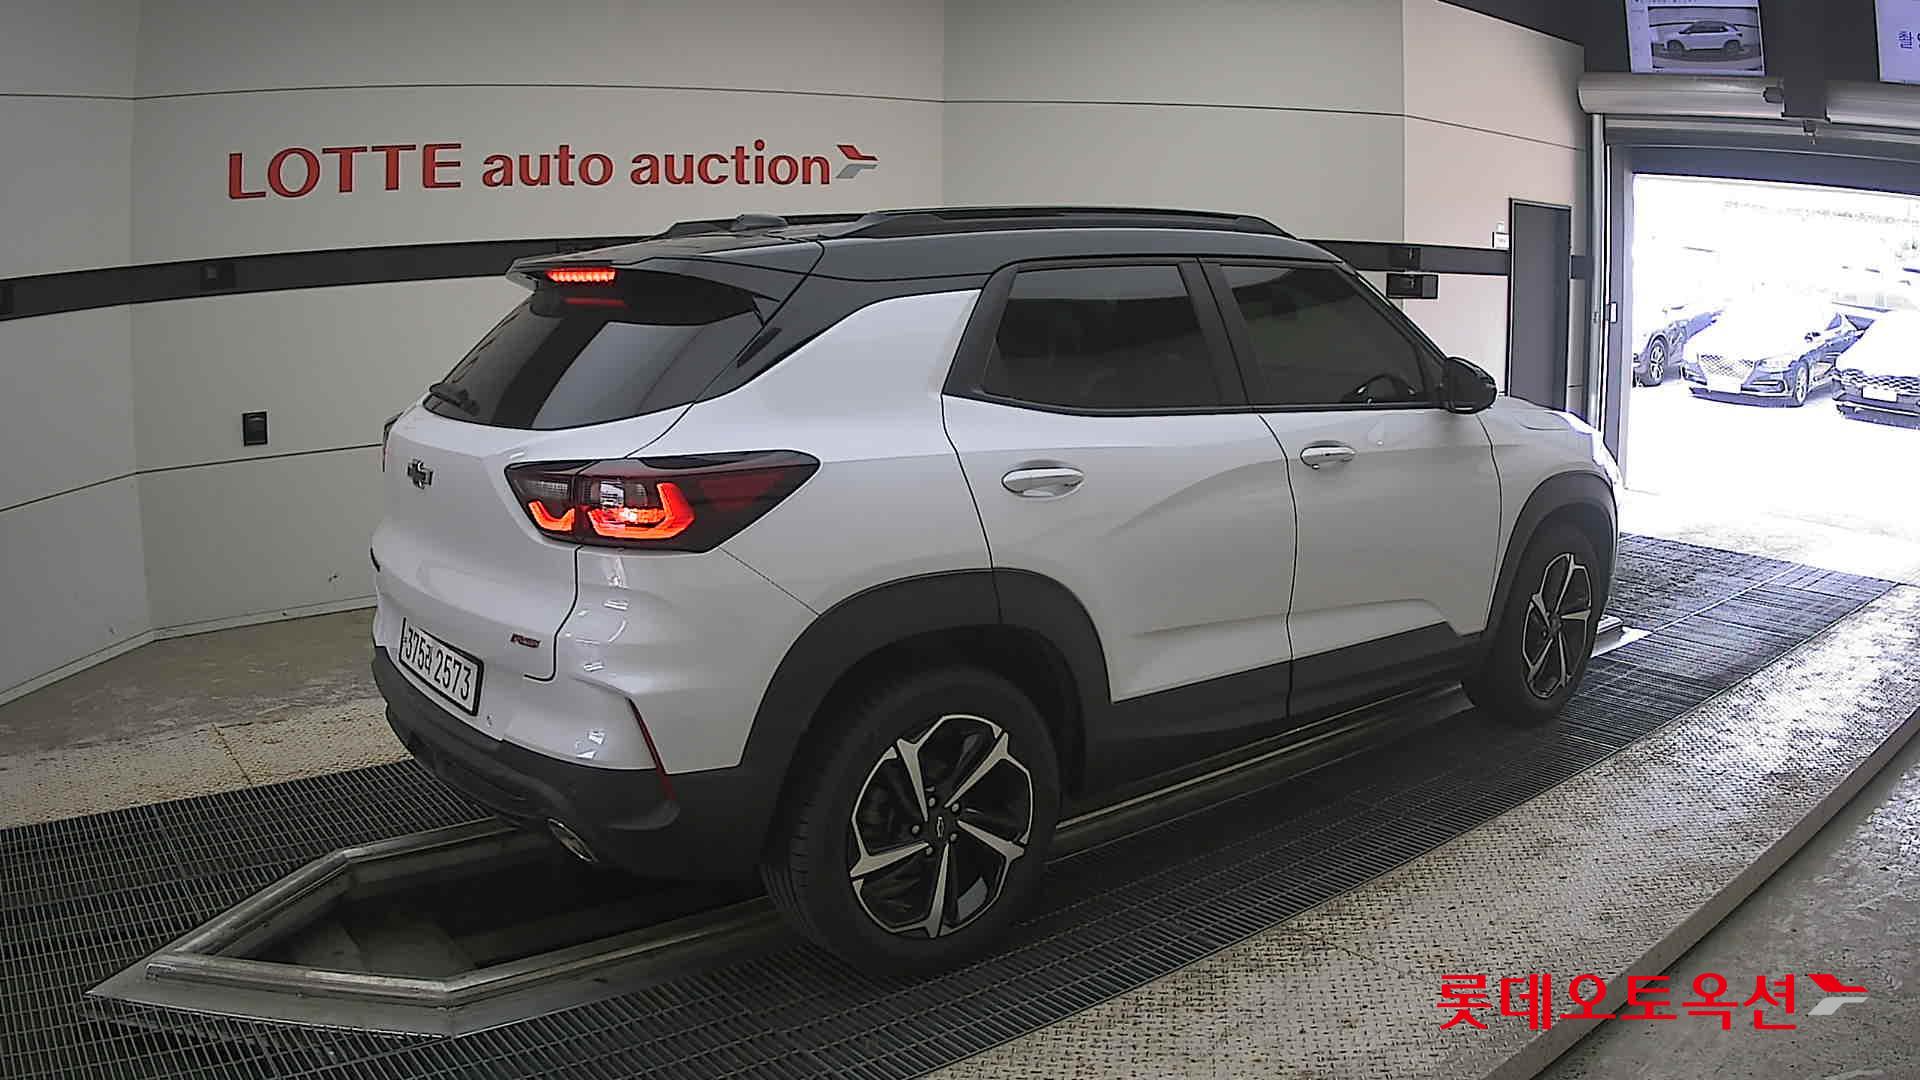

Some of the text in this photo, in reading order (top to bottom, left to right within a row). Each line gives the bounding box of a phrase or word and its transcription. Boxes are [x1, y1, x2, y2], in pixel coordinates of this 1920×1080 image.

[228, 139, 832, 199] LOTTE auto auction
[434, 648, 472, 701] 2573
